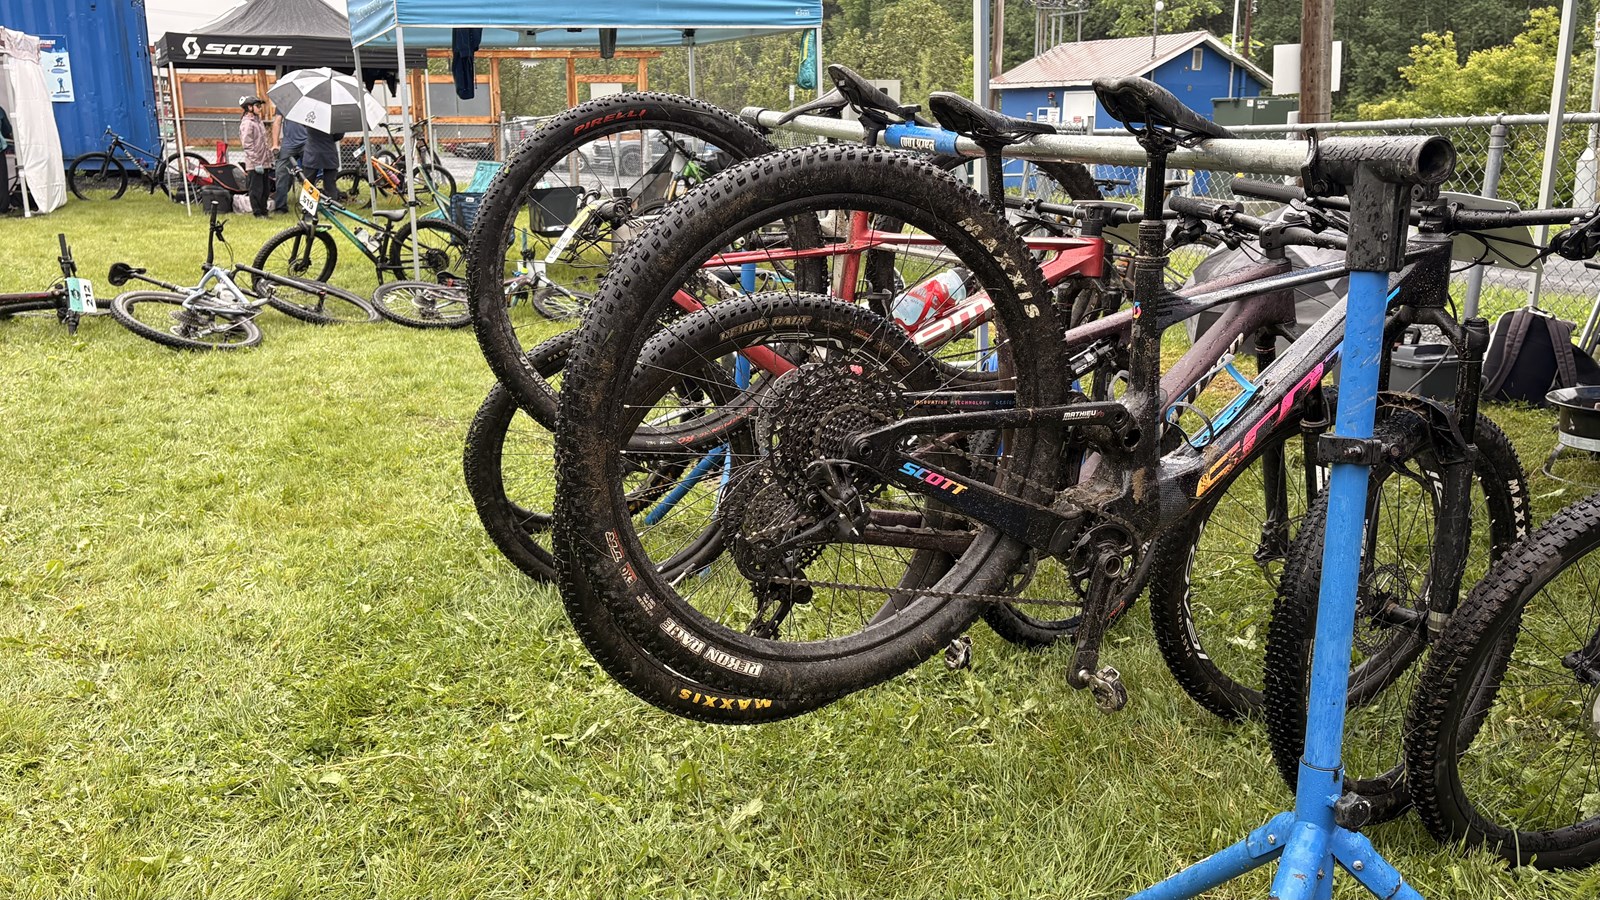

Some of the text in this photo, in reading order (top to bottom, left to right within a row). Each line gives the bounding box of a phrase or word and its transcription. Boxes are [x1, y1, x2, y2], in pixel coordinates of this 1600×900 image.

[203, 43, 293, 57] SCOTT
[573, 109, 647, 136] PIRELLI
[956, 217, 1040, 318] MAXXIS
[84, 285, 93, 307] 212
[519, 356, 554, 396] DT SWISS
[1063, 410, 1097, 418] MATHIEU
[898, 462, 968, 495] SCOTT
[1507, 478, 1526, 539] MAXX
[659, 617, 764, 678] REKON RACE
[679, 688, 772, 711] MAXXIS
